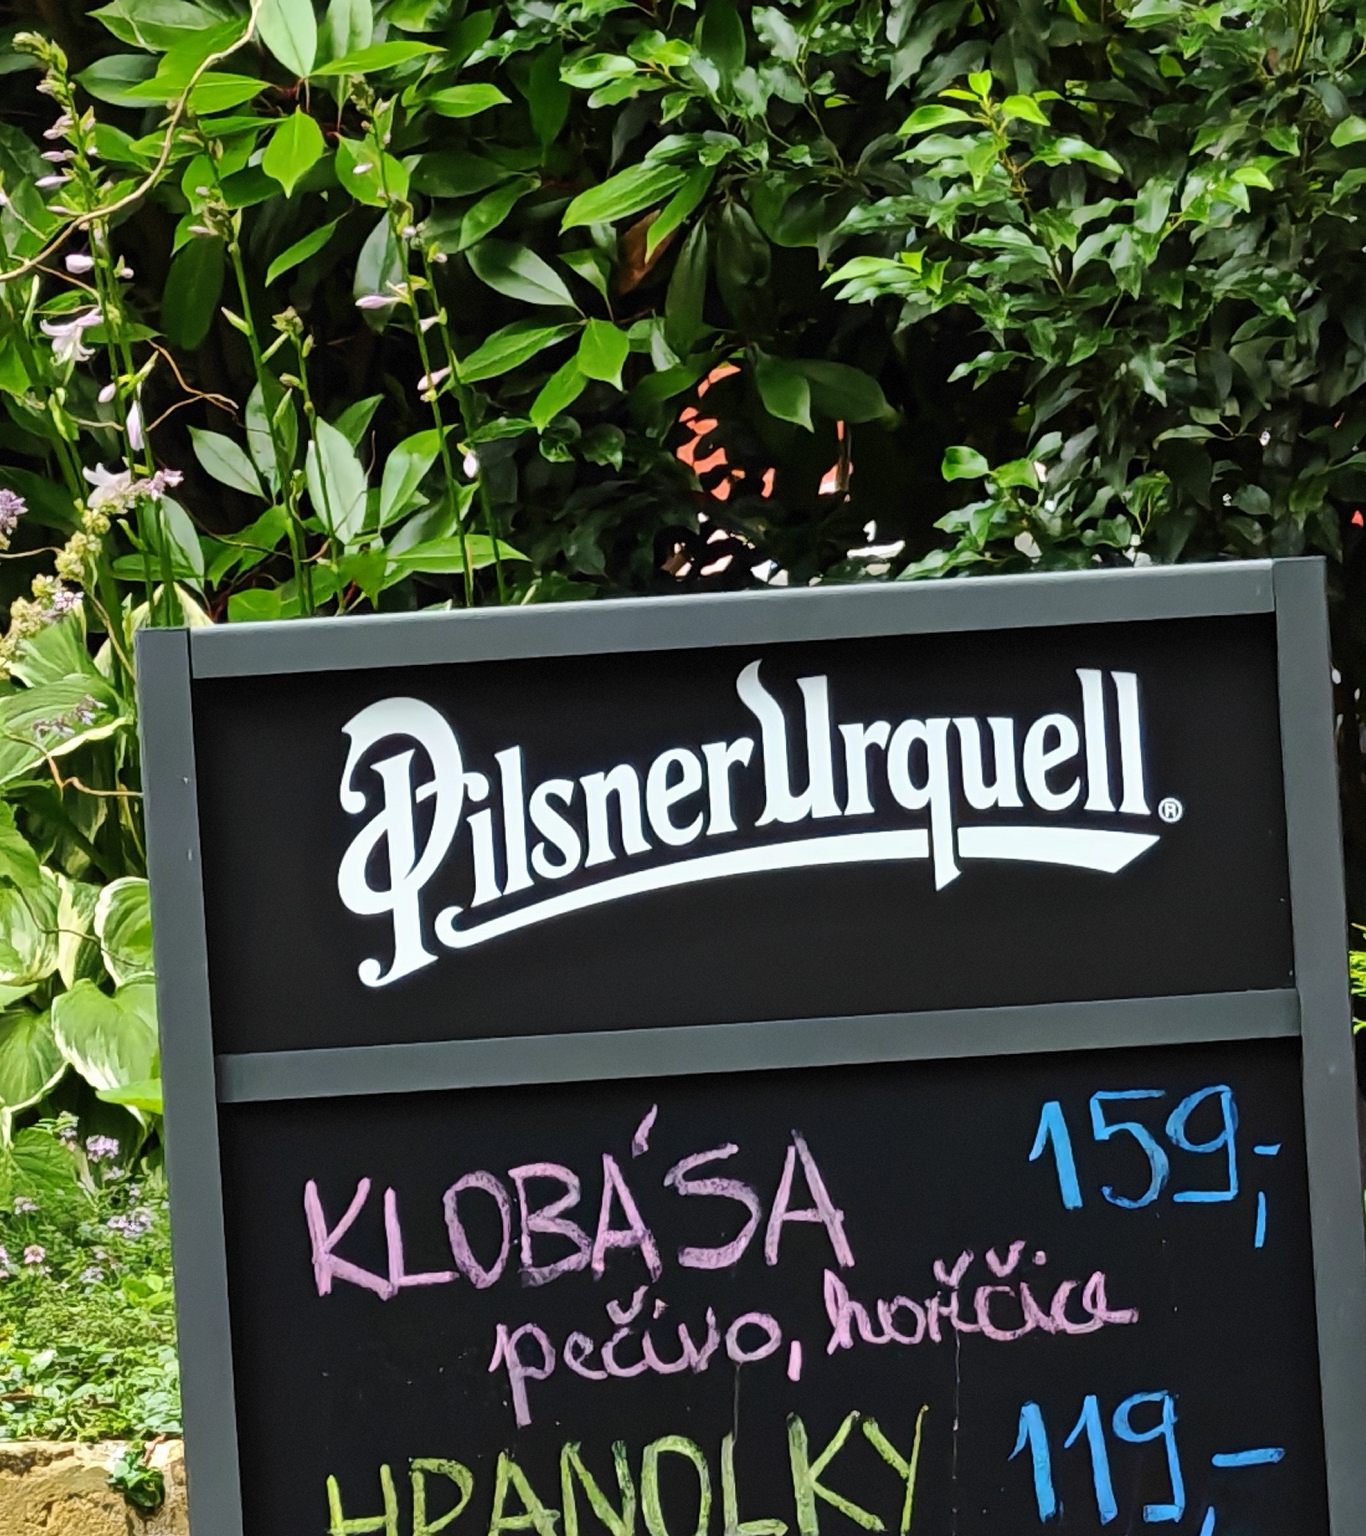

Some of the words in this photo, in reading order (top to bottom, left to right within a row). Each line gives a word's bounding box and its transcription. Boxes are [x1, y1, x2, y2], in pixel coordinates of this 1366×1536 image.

[337, 696, 757, 989] Pilsner
[735, 660, 1151, 893] Urquell
[304, 1104, 856, 1300] KLOBÁSA
